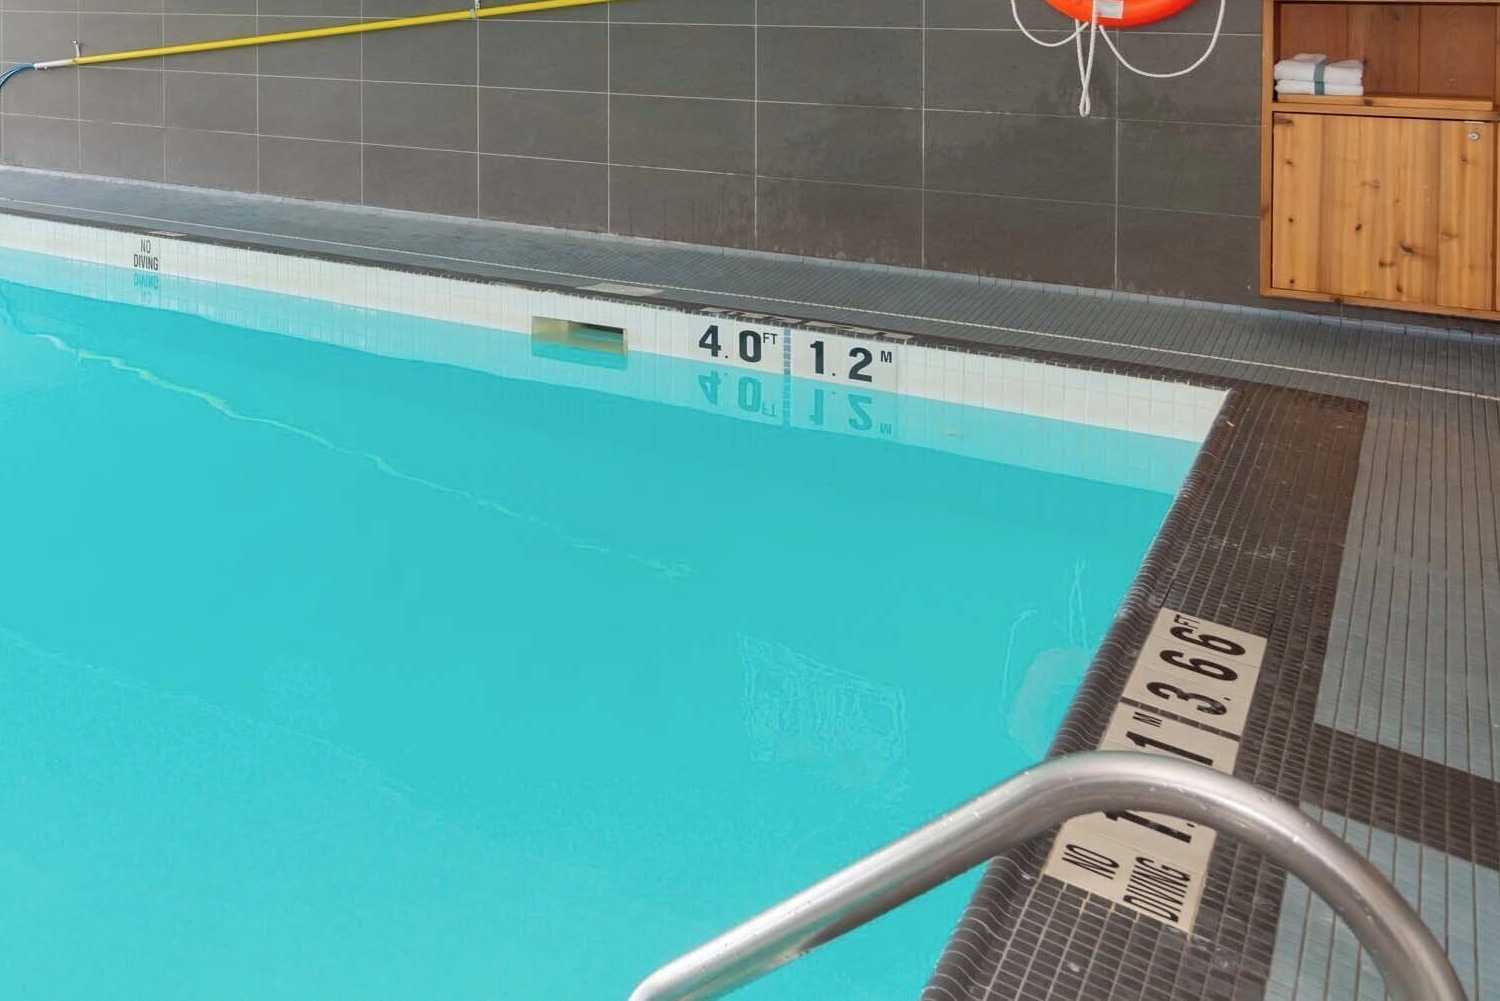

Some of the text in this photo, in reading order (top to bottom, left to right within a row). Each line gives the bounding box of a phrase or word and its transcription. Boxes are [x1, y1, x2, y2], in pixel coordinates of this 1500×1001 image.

[140, 239, 152, 254] NO
[133, 254, 158, 271] DIVING
[1062, 844, 1120, 880] NO
[1123, 856, 1191, 923] DIVING
